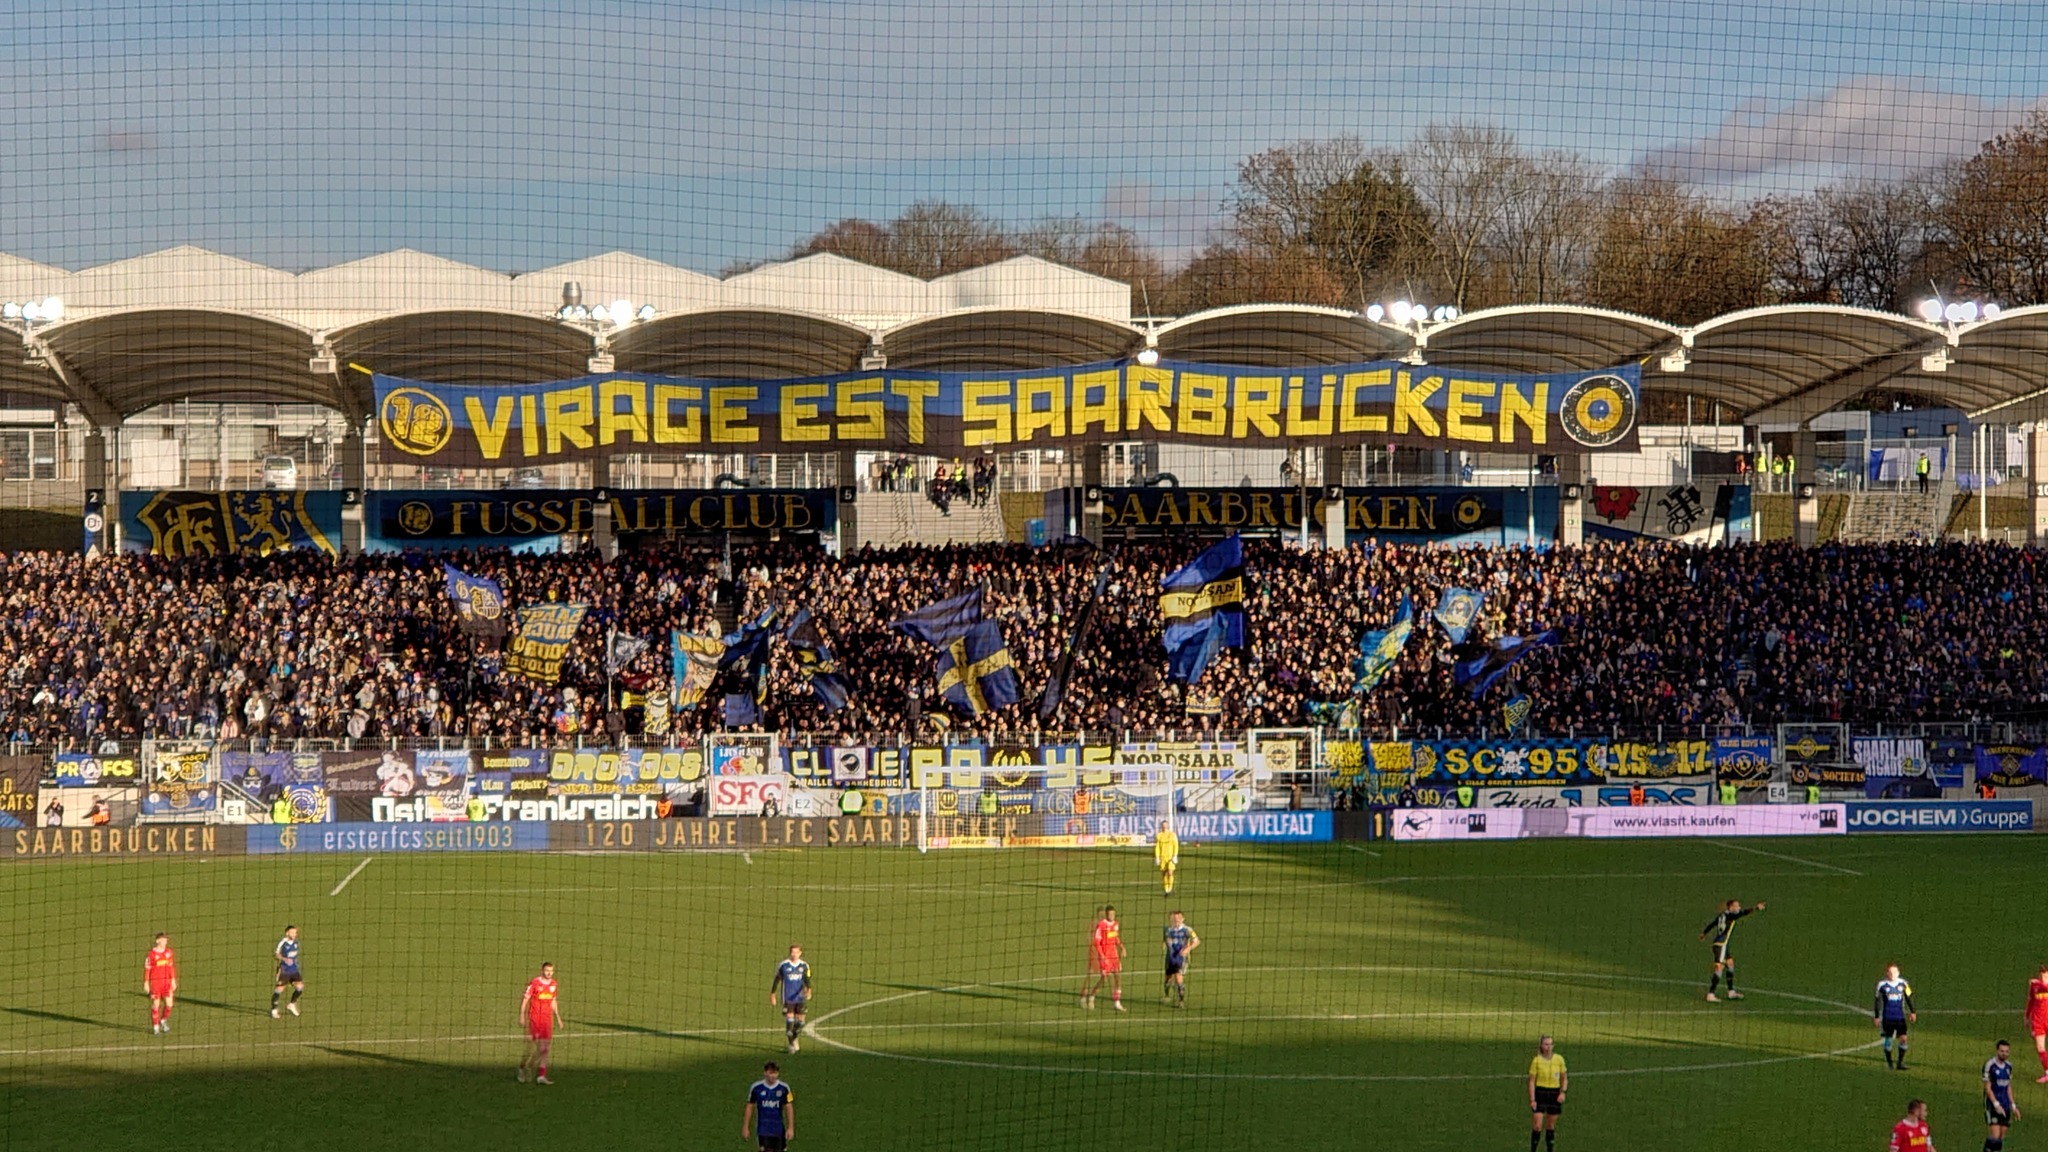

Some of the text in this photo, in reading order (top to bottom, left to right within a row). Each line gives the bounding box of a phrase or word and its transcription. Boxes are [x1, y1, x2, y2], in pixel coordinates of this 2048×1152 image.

[464, 365, 1549, 459] VIRAGE EST SAARBRÜCKEN
[90, 492, 98, 503] 2
[346, 491, 354, 501] 3
[598, 490, 606, 500] 4
[844, 491, 852, 500] 5
[1088, 488, 1098, 498] 6
[1331, 488, 1339, 498] 7
[1568, 487, 1576, 497] 8
[1803, 486, 1812, 497] 9
[1676, 740, 1708, 775] 17
[1854, 739, 1924, 764] SAARLAND
[1121, 752, 1235, 768] NORDSAAR
[1444, 748, 1578, 775] SC 95
[103, 760, 134, 777] FCS
[717, 780, 782, 805] SFC
[1770, 787, 1785, 798] E4
[227, 805, 242, 816] E1
[795, 800, 811, 809] E2
[1223, 813, 1246, 836] IST
[1249, 812, 1315, 836] VIELFALT
[1613, 814, 1736, 829] www.viasit.kaufen
[1848, 808, 2028, 829] JOCHEM Gruppe
[16, 826, 216, 854] SAARBRÜCKEN
[587, 822, 633, 846] 120
[656, 820, 737, 846] JAHRE
